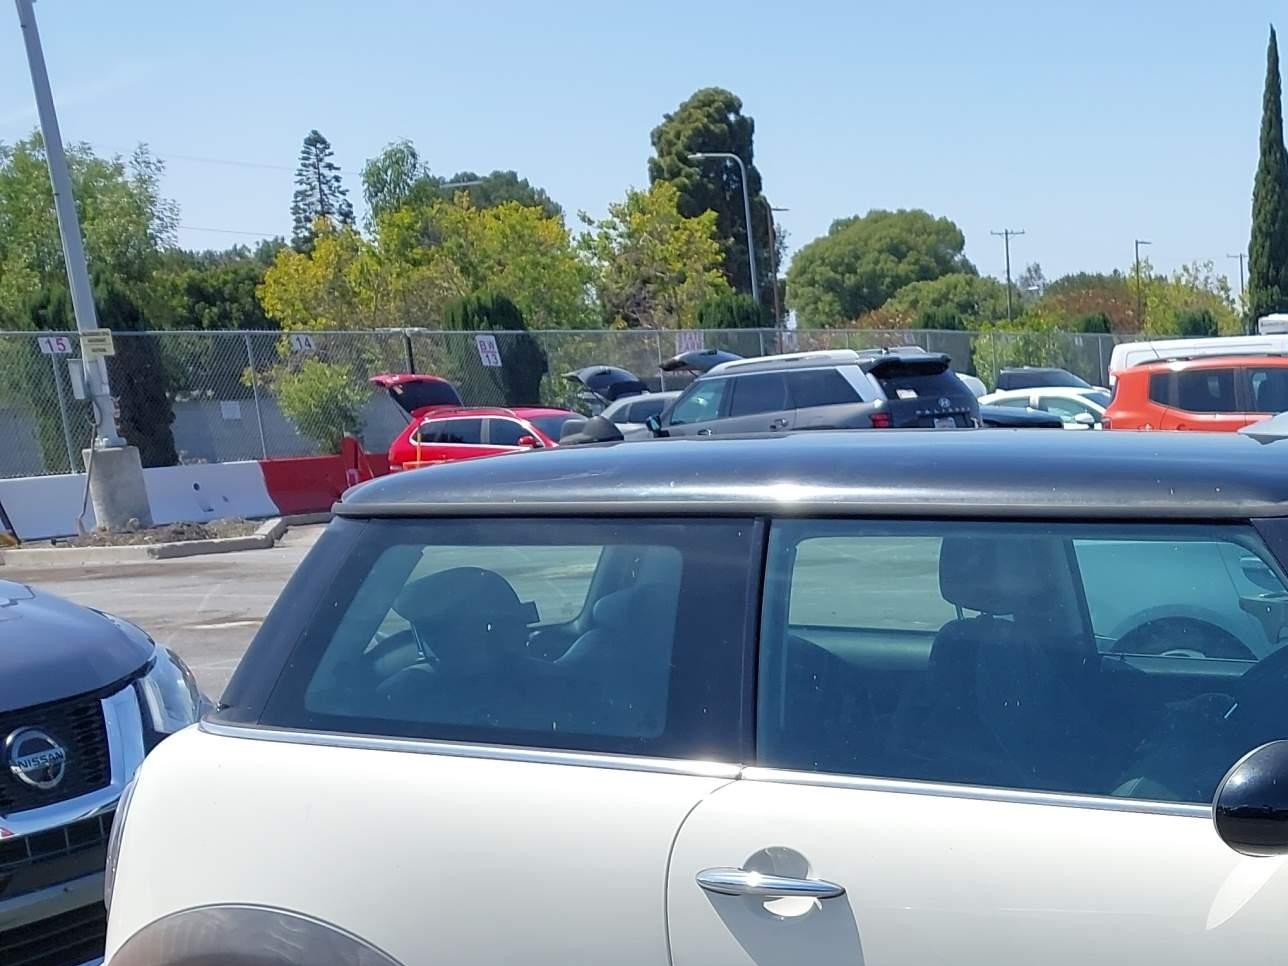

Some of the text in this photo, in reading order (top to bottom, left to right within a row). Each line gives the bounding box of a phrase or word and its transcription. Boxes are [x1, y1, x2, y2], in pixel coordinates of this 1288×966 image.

[45, 337, 66, 352] 15
[296, 335, 312, 350] 14
[485, 353, 499, 366] 13
[16, 751, 64, 769] NISSAN
